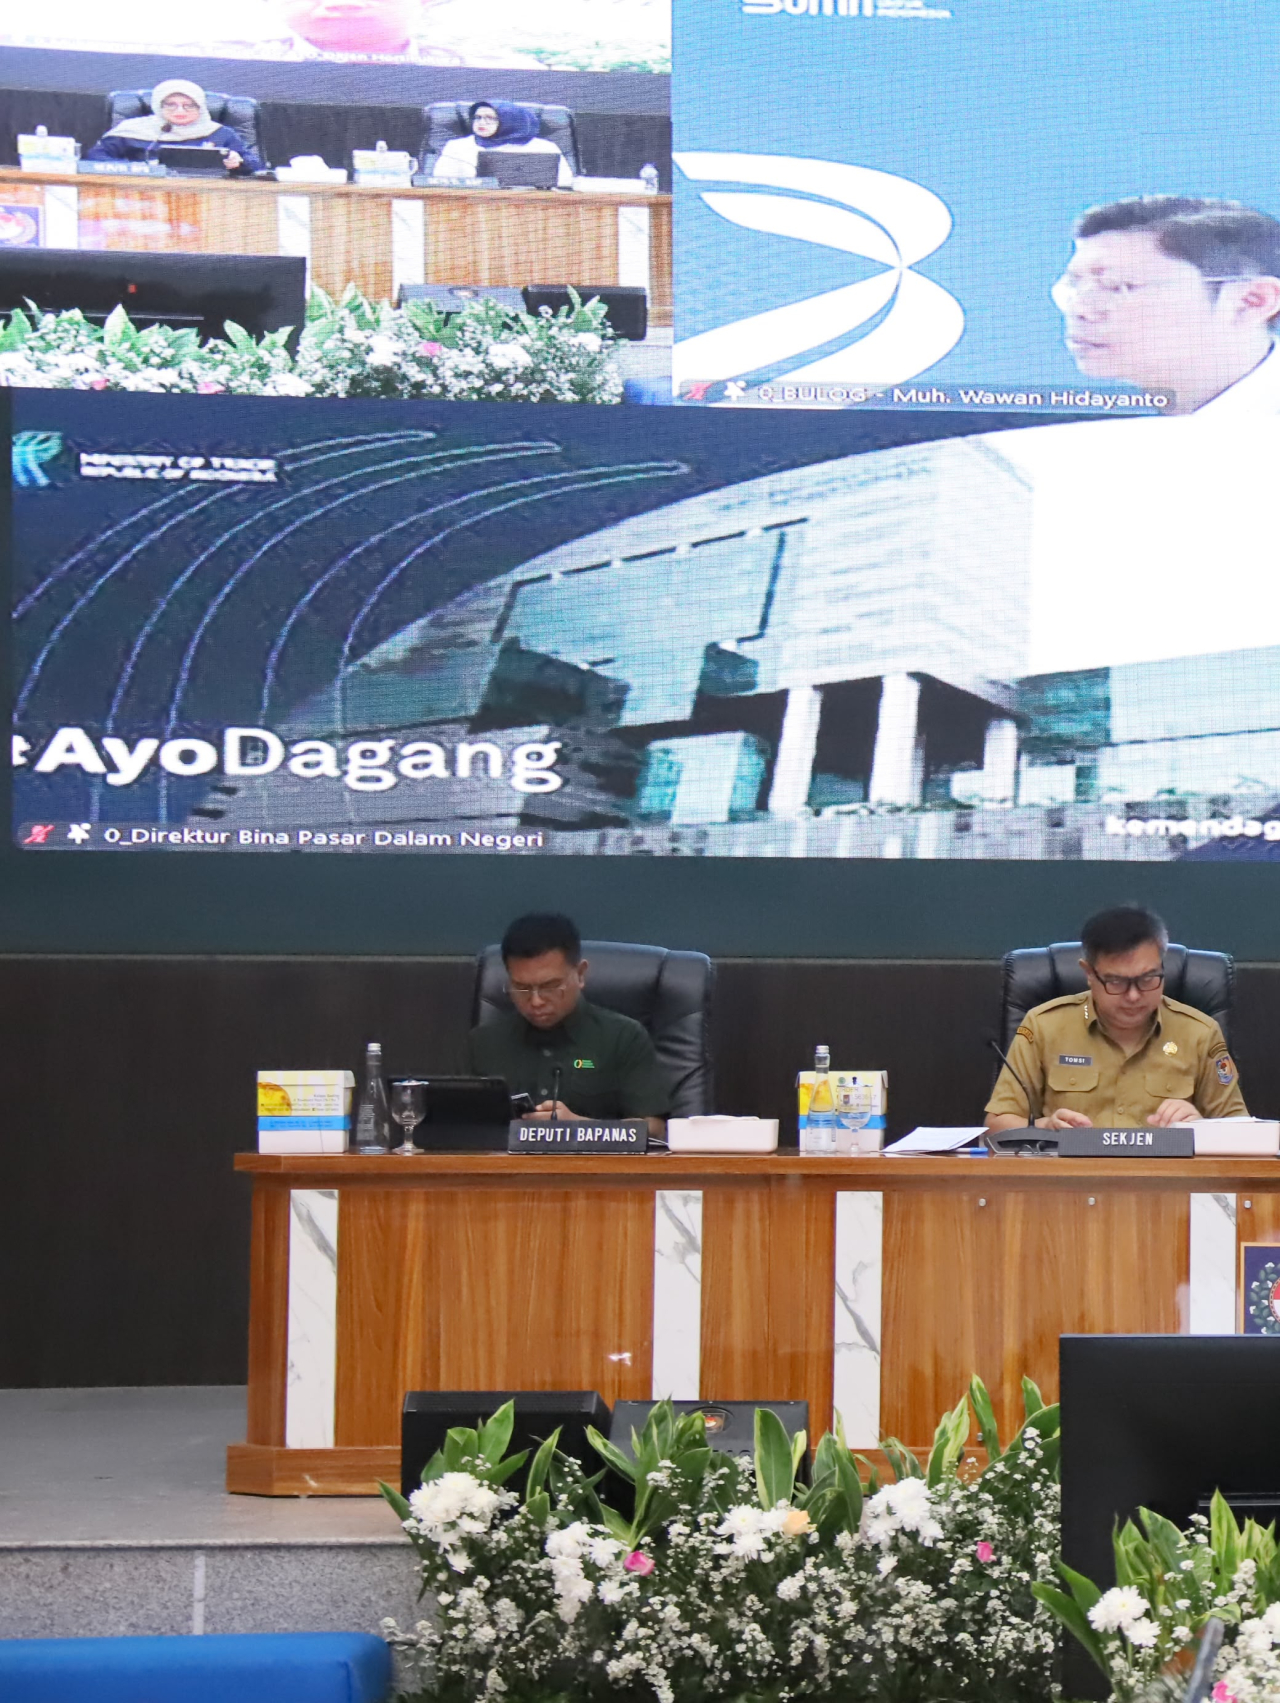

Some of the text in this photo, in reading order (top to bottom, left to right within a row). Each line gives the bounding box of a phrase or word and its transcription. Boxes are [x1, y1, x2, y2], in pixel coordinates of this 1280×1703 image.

[893, 387, 951, 403] Muh.
[959, 389, 1043, 405] Wawan
[1051, 390, 1168, 410] Hidayanto
[238, 829, 289, 845] Bina
[298, 830, 366, 846] Pasar
[374, 830, 451, 846] Dalam
[460, 831, 543, 851] Negeri
[520, 1127, 637, 1142] DEPUTI BAPANAS
[1102, 1132, 1153, 1146] SEKJEN
